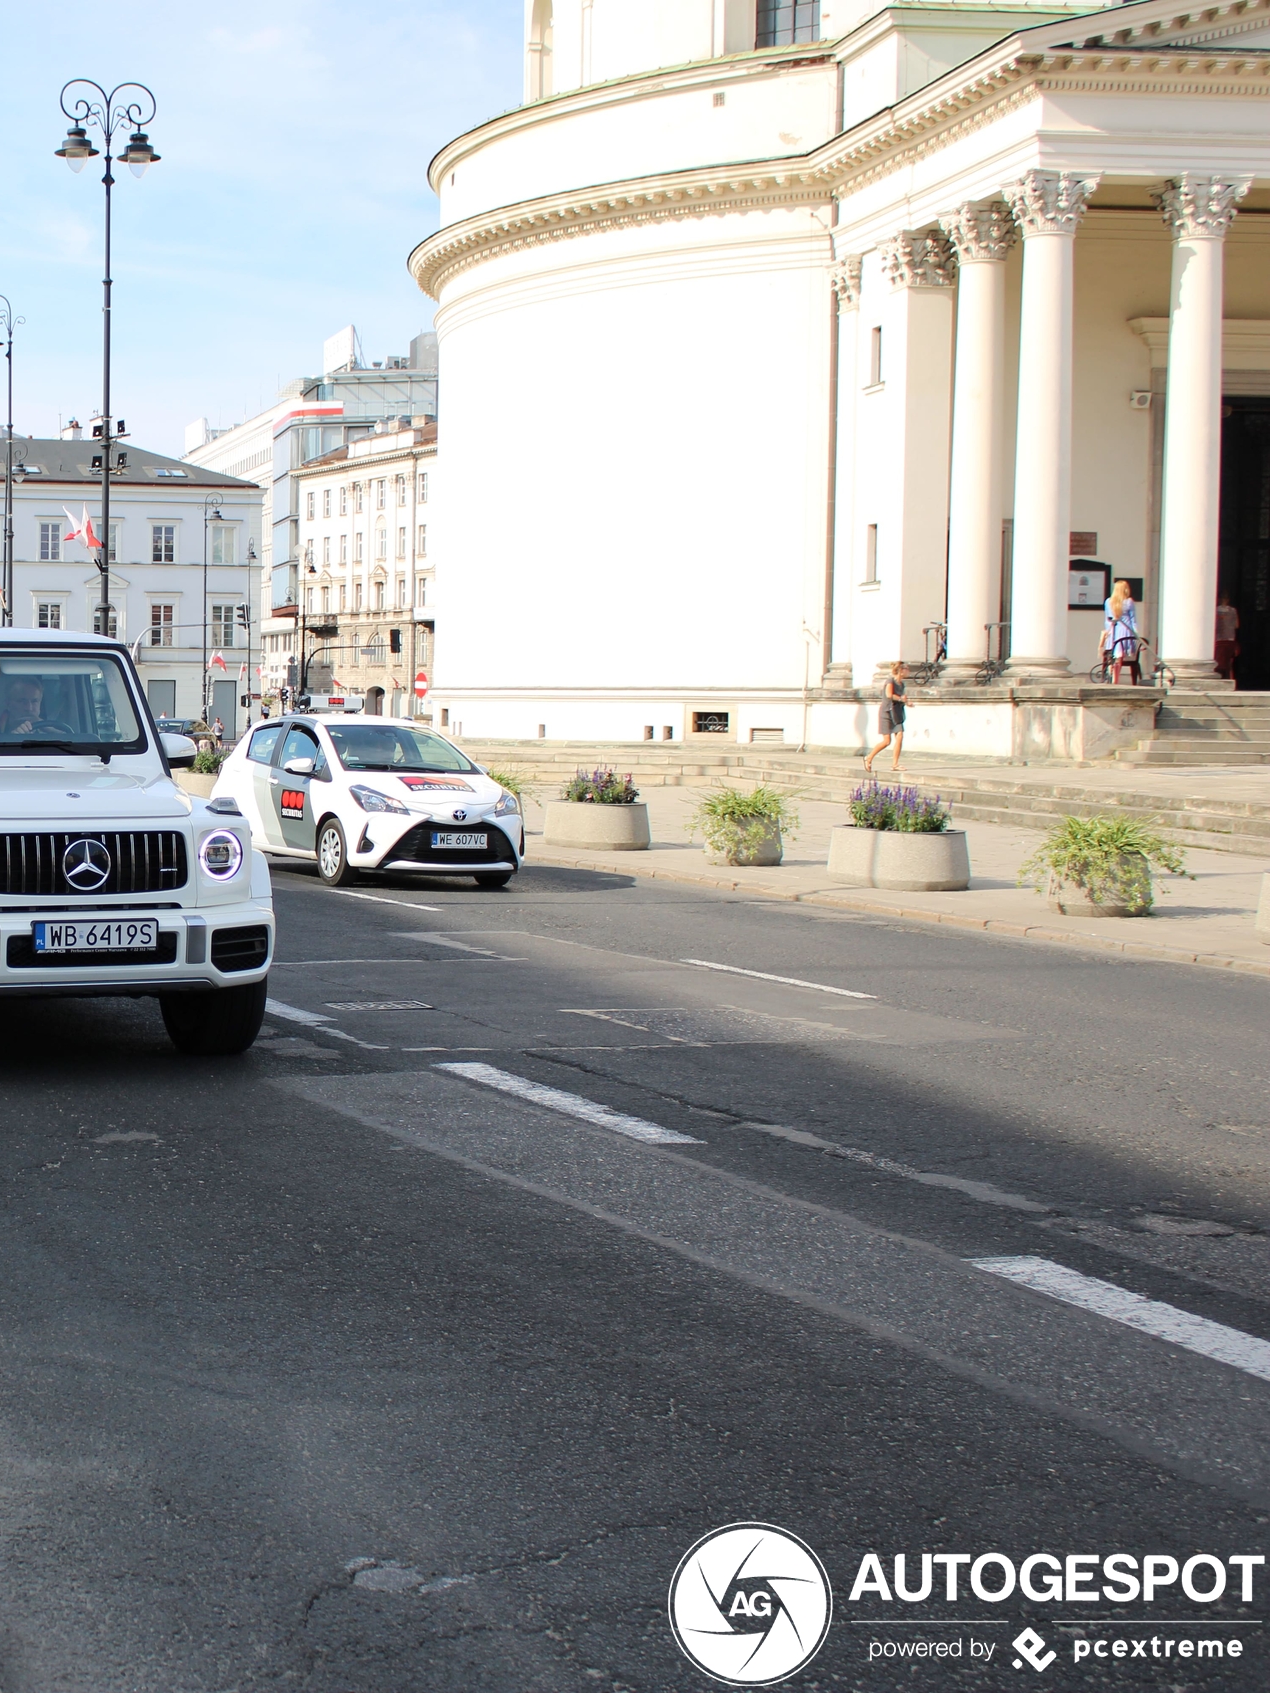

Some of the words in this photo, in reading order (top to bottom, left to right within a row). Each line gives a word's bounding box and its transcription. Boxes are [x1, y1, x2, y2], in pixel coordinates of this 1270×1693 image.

[410, 784, 473, 792] SECURITAS
[439, 834, 452, 845] WE
[455, 834, 486, 845] 607VC
[50, 925, 77, 946] WB
[86, 923, 152, 946] 6419S
